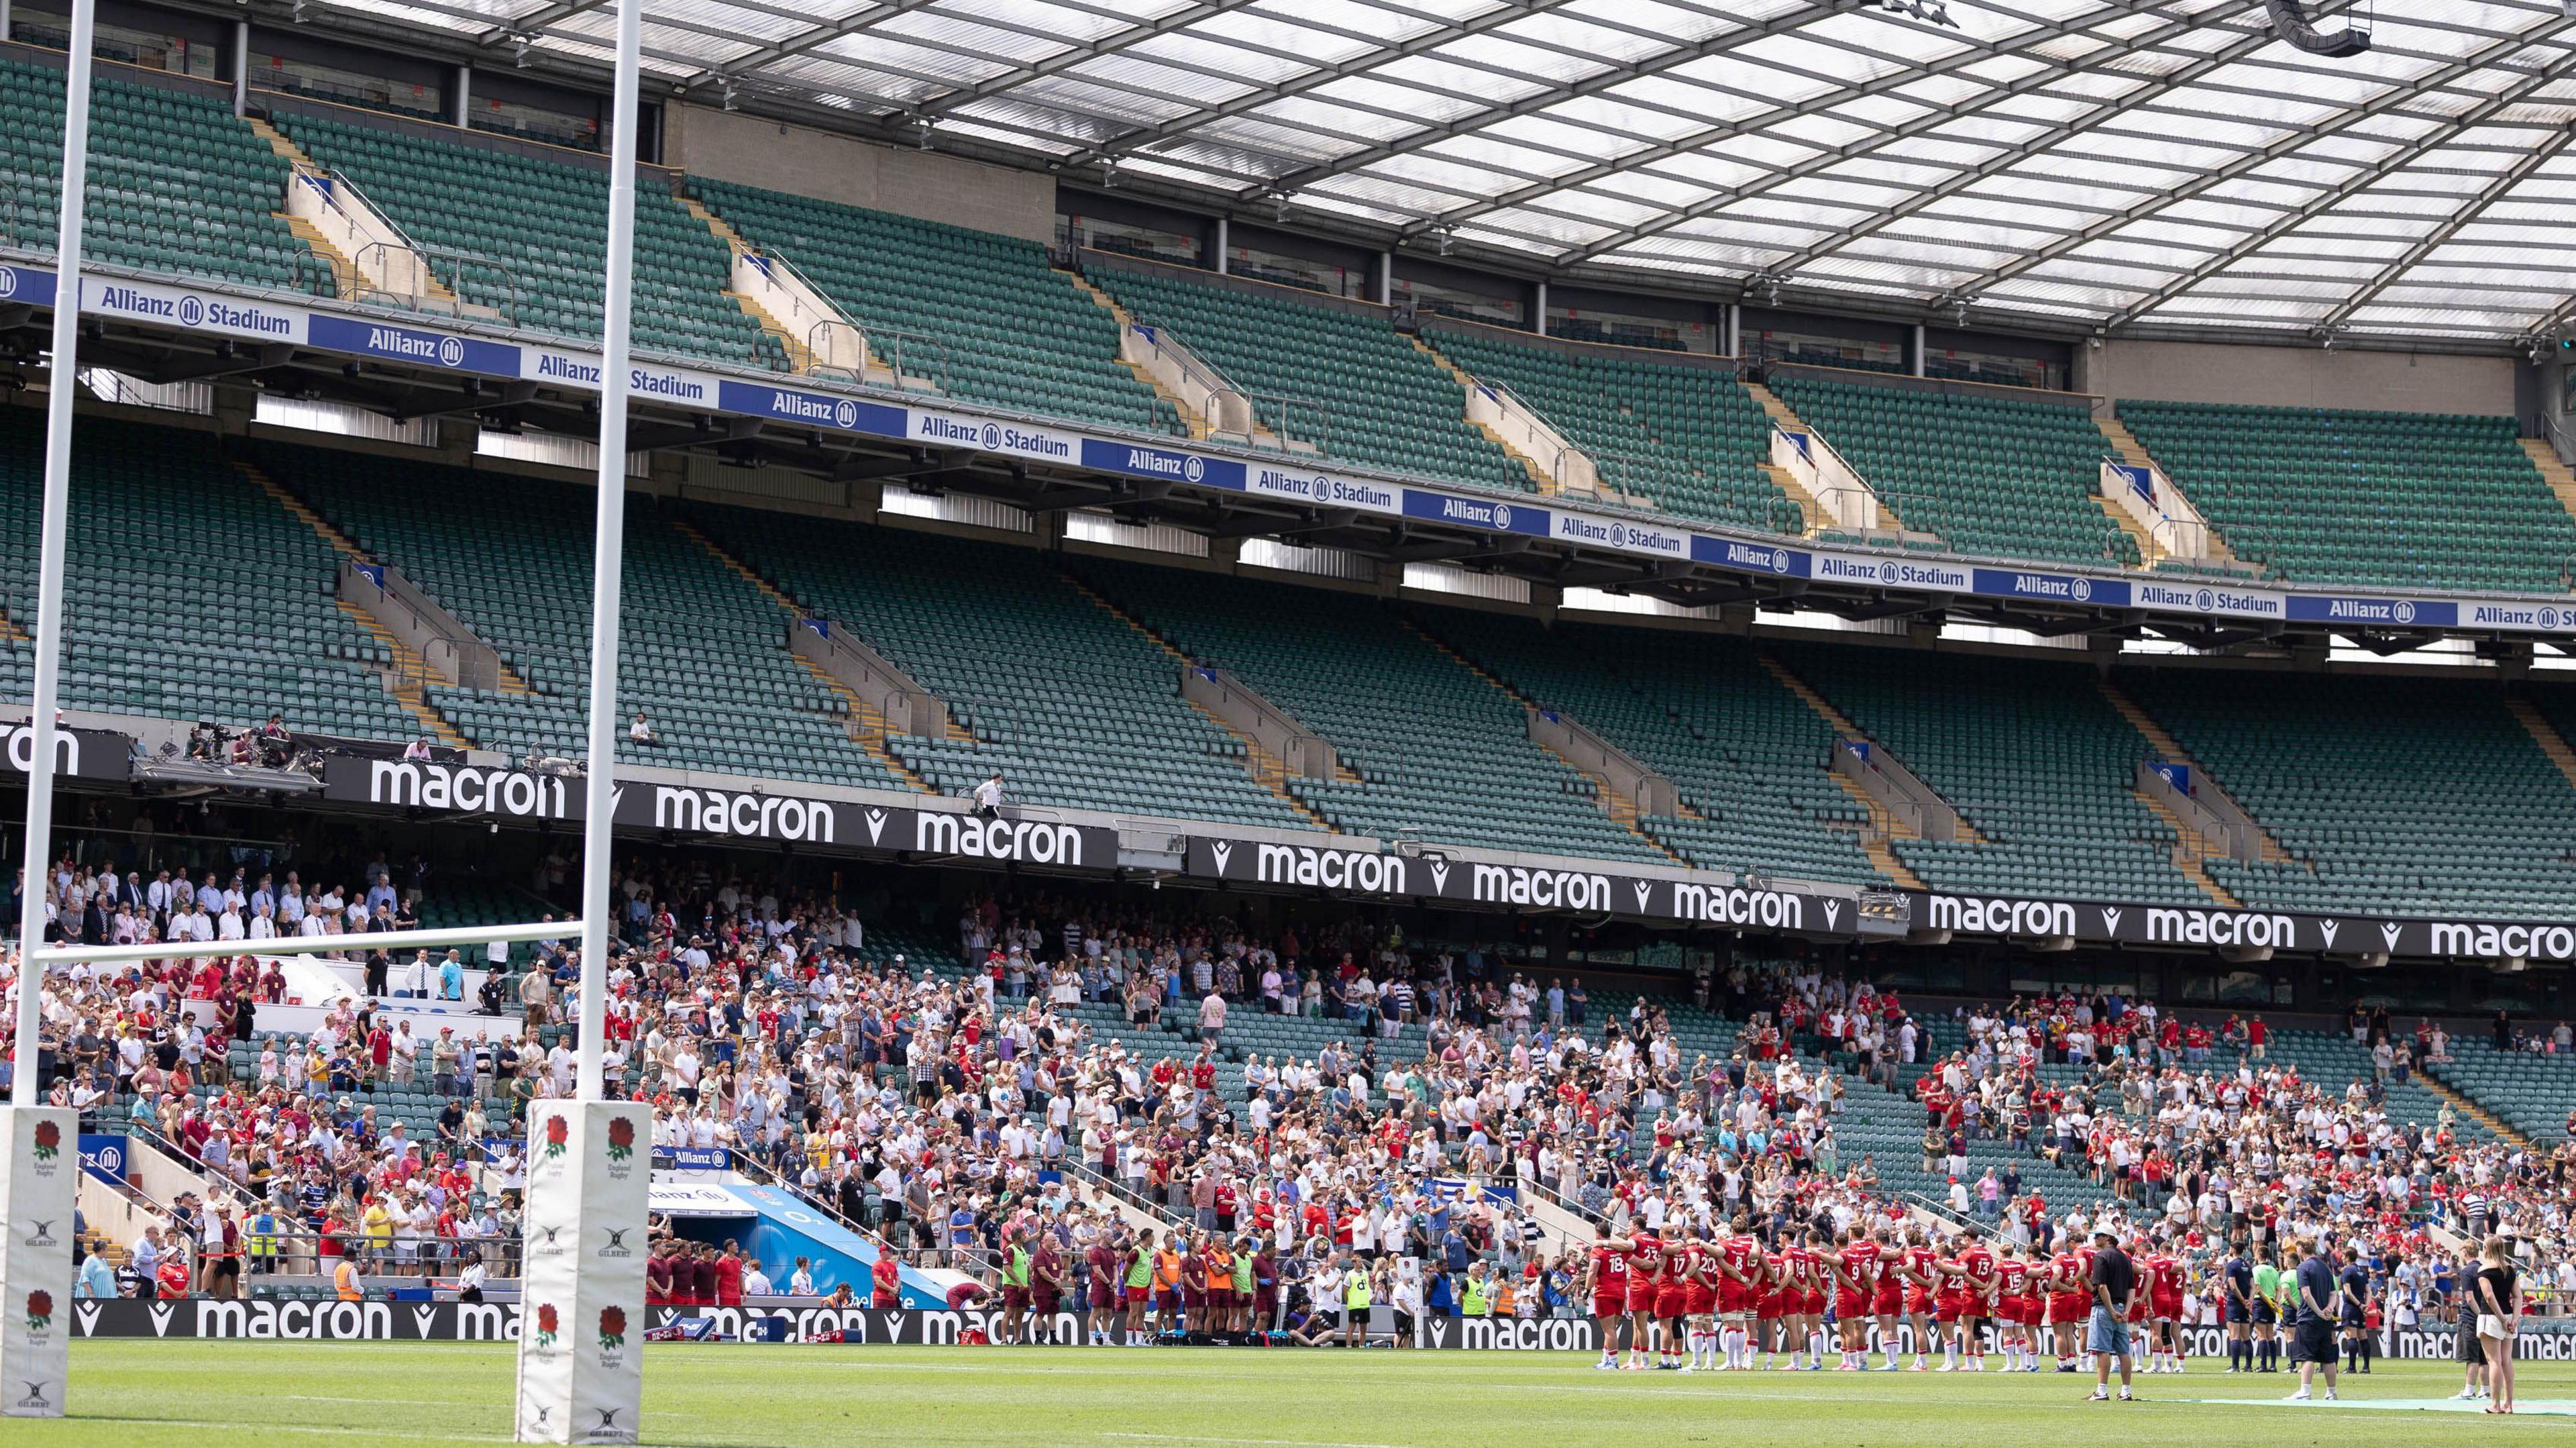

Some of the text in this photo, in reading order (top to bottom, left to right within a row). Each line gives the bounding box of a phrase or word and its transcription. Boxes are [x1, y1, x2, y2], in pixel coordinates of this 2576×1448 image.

[102, 287, 290, 335] Allianz Stadium
[368, 327, 435, 358] Allianz
[538, 354, 703, 400] Allianz Stadium
[771, 392, 832, 421] Allianz
[921, 416, 1069, 457] Allianz Stadium
[1128, 449, 1181, 475] Allianz
[1258, 470, 1391, 507] Allianz Stadium
[1443, 499, 1491, 523] Allianz
[1561, 517, 1680, 552] Allianz Stadium
[1727, 544, 1771, 568] Allianz
[1821, 558, 1964, 587] Allianz Stadium
[2015, 575, 2068, 596] Allianz
[2141, 586, 2278, 613] Allianz Stadium
[2328, 601, 2390, 620] Allianz
[2474, 606, 2534, 625] Allianz
[371, 760, 566, 819] macron
[656, 786, 834, 843] macron
[916, 812, 1081, 866] macron
[1258, 844, 1405, 894] macron
[1474, 864, 1611, 911] macron
[1674, 883, 1802, 929] macron
[1929, 894, 2076, 936] macron
[2147, 908, 2295, 948] macron
[2431, 923, 2576, 960] macro
[608, 1164, 631, 1172] England
[676, 1151, 711, 1165] Allianz
[610, 1172, 629, 1181] Rugby
[598, 1250, 631, 1258] GILBERT
[1609, 1256, 1625, 1273] 18
[1673, 1257, 1686, 1273] 17
[1698, 1256, 1716, 1273] 20
[1735, 1255, 1743, 1271] 8
[1795, 1261, 1806, 1278] 14
[1819, 1263, 1831, 1278] 12
[1851, 1265, 1860, 1281] 9
[1922, 1261, 1932, 1277] 11
[1976, 1261, 1990, 1276] 13
[1947, 1274, 1964, 1289] 22
[2007, 1274, 2022, 1289] 15
[2175, 1274, 2183, 1288] 2
[197, 1300, 392, 1339] macron
[1462, 1318, 1593, 1351] macron
[599, 1353, 623, 1361] England
[602, 1361, 621, 1369] Rugby
